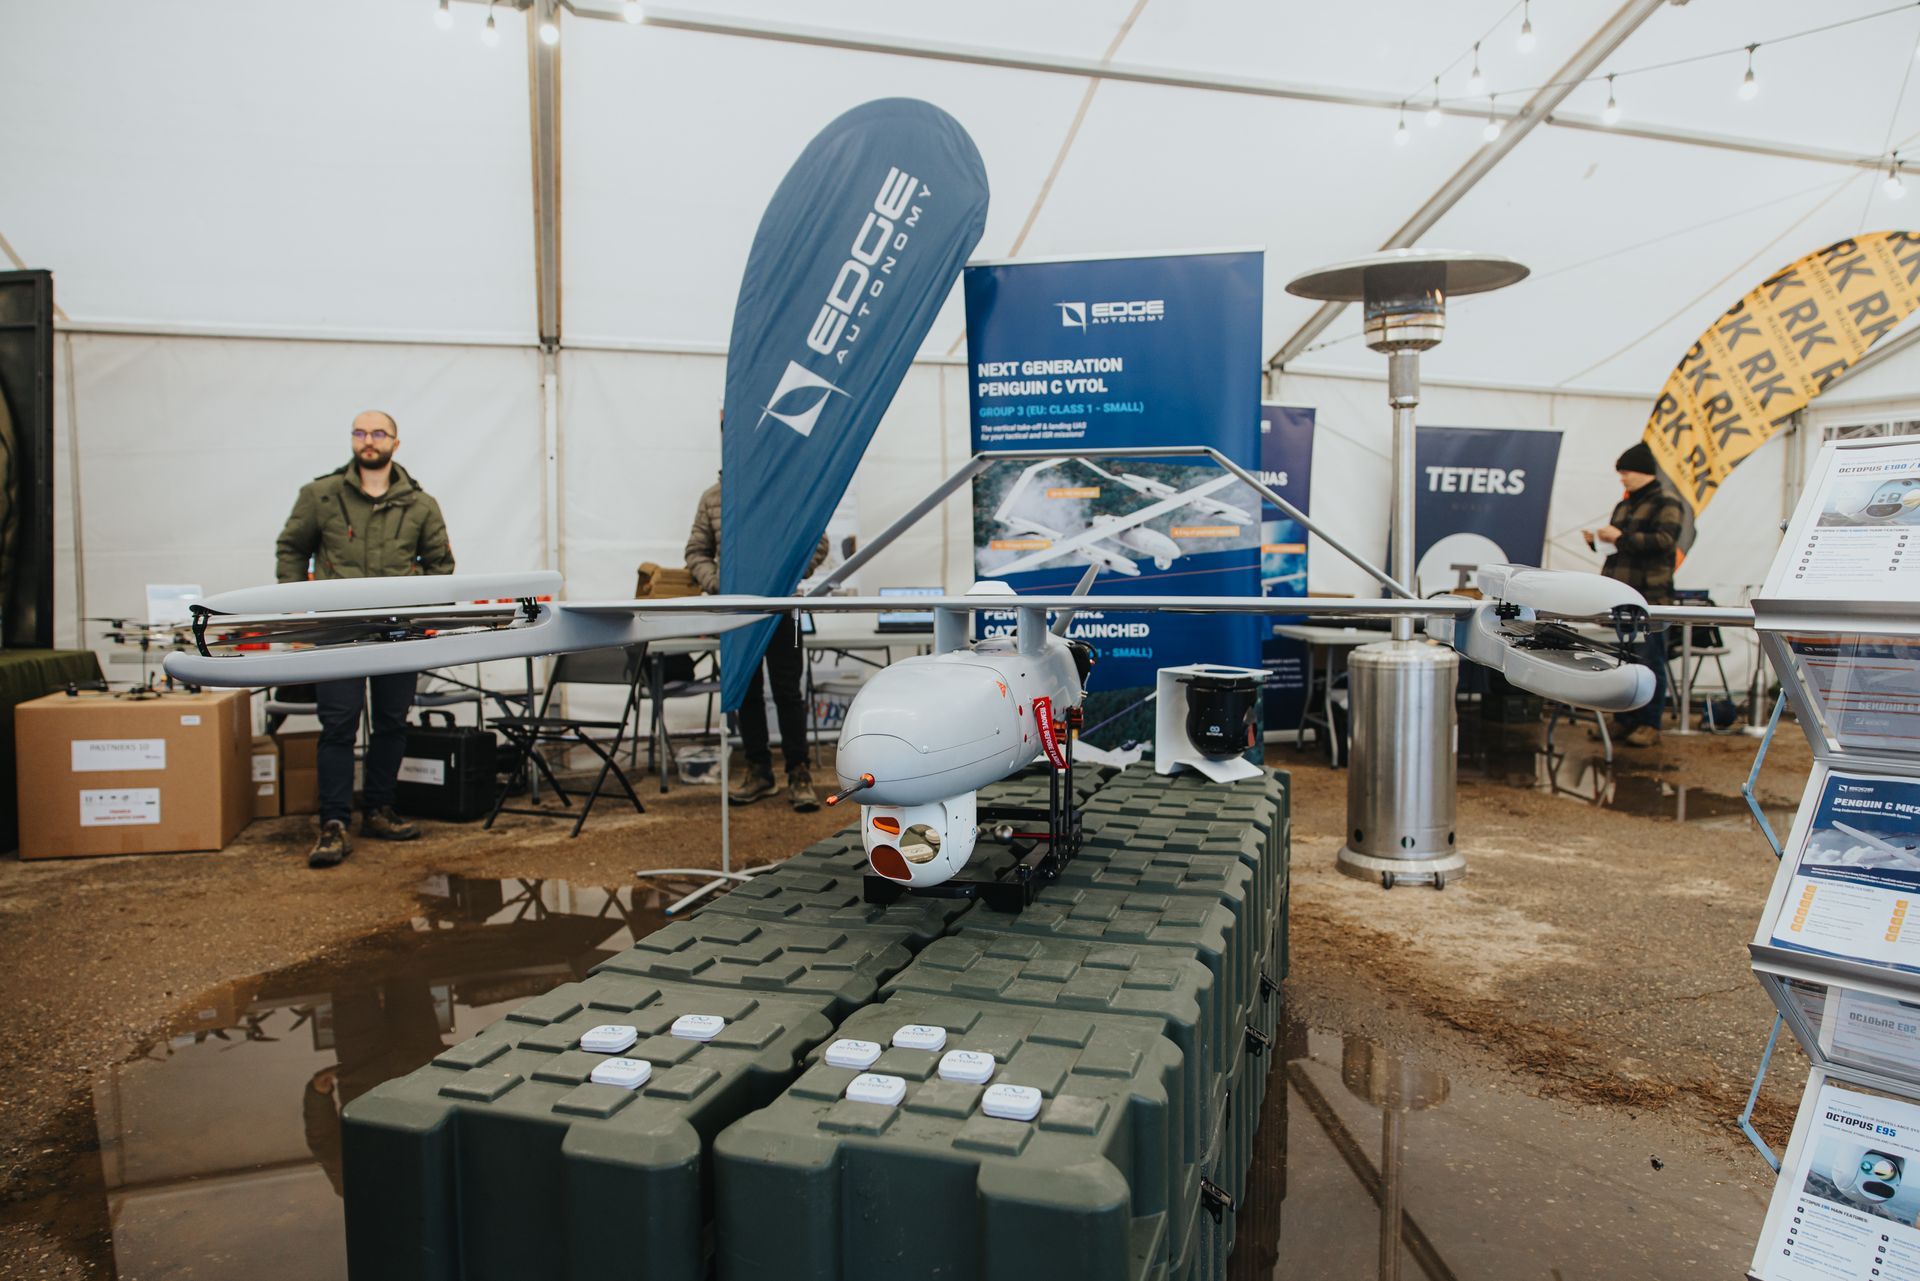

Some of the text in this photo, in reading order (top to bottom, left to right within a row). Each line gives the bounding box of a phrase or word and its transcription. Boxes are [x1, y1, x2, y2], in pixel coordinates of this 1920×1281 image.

[806, 166, 920, 356] EDGE
[836, 184, 932, 365] AUTONOMY
[1091, 300, 1165, 318] EDGE
[1092, 315, 1165, 325] AUTONOMY
[1778, 297, 1838, 360] RK
[978, 357, 1123, 378] NEXT GENERATION
[978, 378, 1109, 398] PENGUIN C VTOL
[1737, 349, 1796, 412] RK
[979, 405, 1016, 418] GROUP
[1016, 405, 1025, 417] 3
[1026, 404, 1048, 418] (EU:
[1049, 403, 1085, 416] CLASS
[1087, 403, 1094, 414] 1
[1103, 401, 1145, 414] SMALL)
[981, 425, 993, 433] The
[993, 424, 1017, 433] vertical
[1048, 422, 1071, 433] landing
[1652, 392, 1694, 449] RK
[1702, 390, 1753, 451] RK
[1029, 432, 1042, 440] and
[1261, 471, 1289, 487] UAS
[1684, 444, 1719, 503] RK
[1838, 465, 1883, 473] OCTOPUS
[1425, 466, 1526, 496] TETERS
[1065, 623, 1151, 639] LAUNCHED
[1112, 647, 1154, 660] SMALL)
[1040, 707, 1063, 768] REMOVE BEFORE FLIGHT
[1833, 797, 1920, 815] PENGUIN C MK2
[1825, 1111, 1874, 1131] OCTOPUS
[1876, 1124, 1897, 1138] E95
